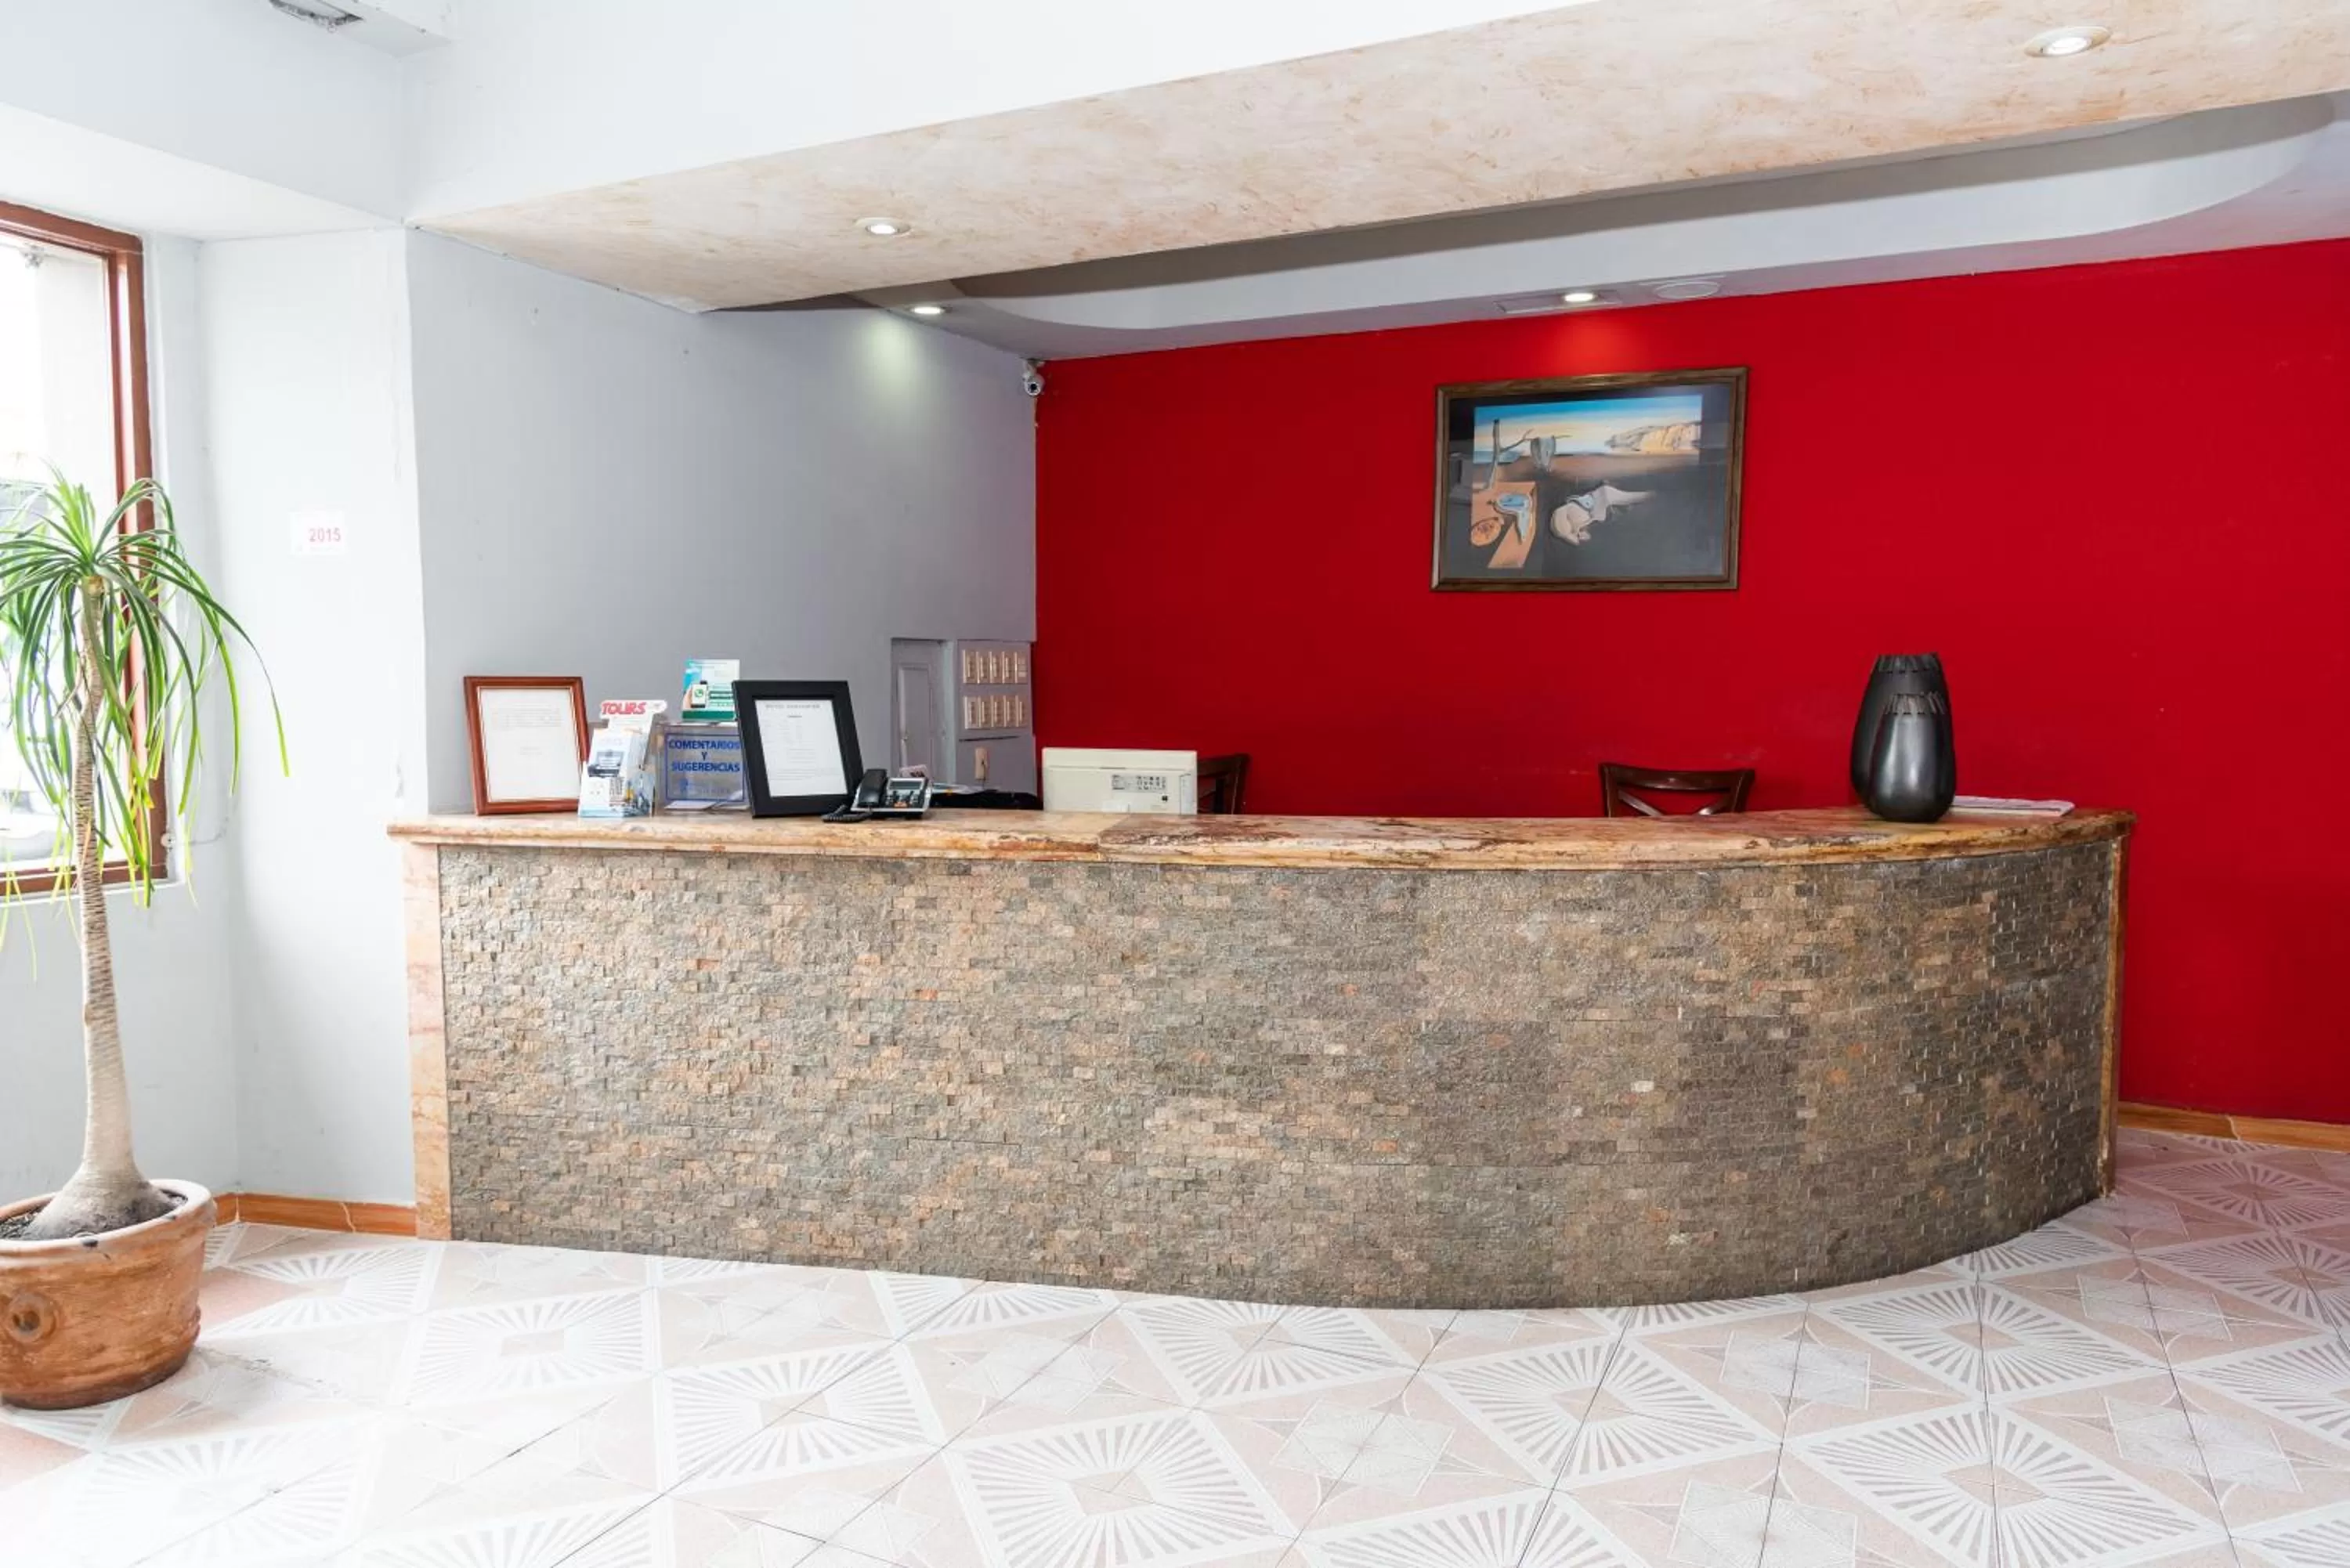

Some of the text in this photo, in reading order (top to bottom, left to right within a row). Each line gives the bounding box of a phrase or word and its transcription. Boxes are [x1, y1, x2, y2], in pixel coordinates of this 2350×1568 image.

[309, 527, 342, 543] 2015
[602, 702, 647, 715] TOURS
[668, 739, 740, 750] COMENTARIOS
[701, 751, 708, 761] Y
[671, 761, 740, 772] SUGERENCIAS
